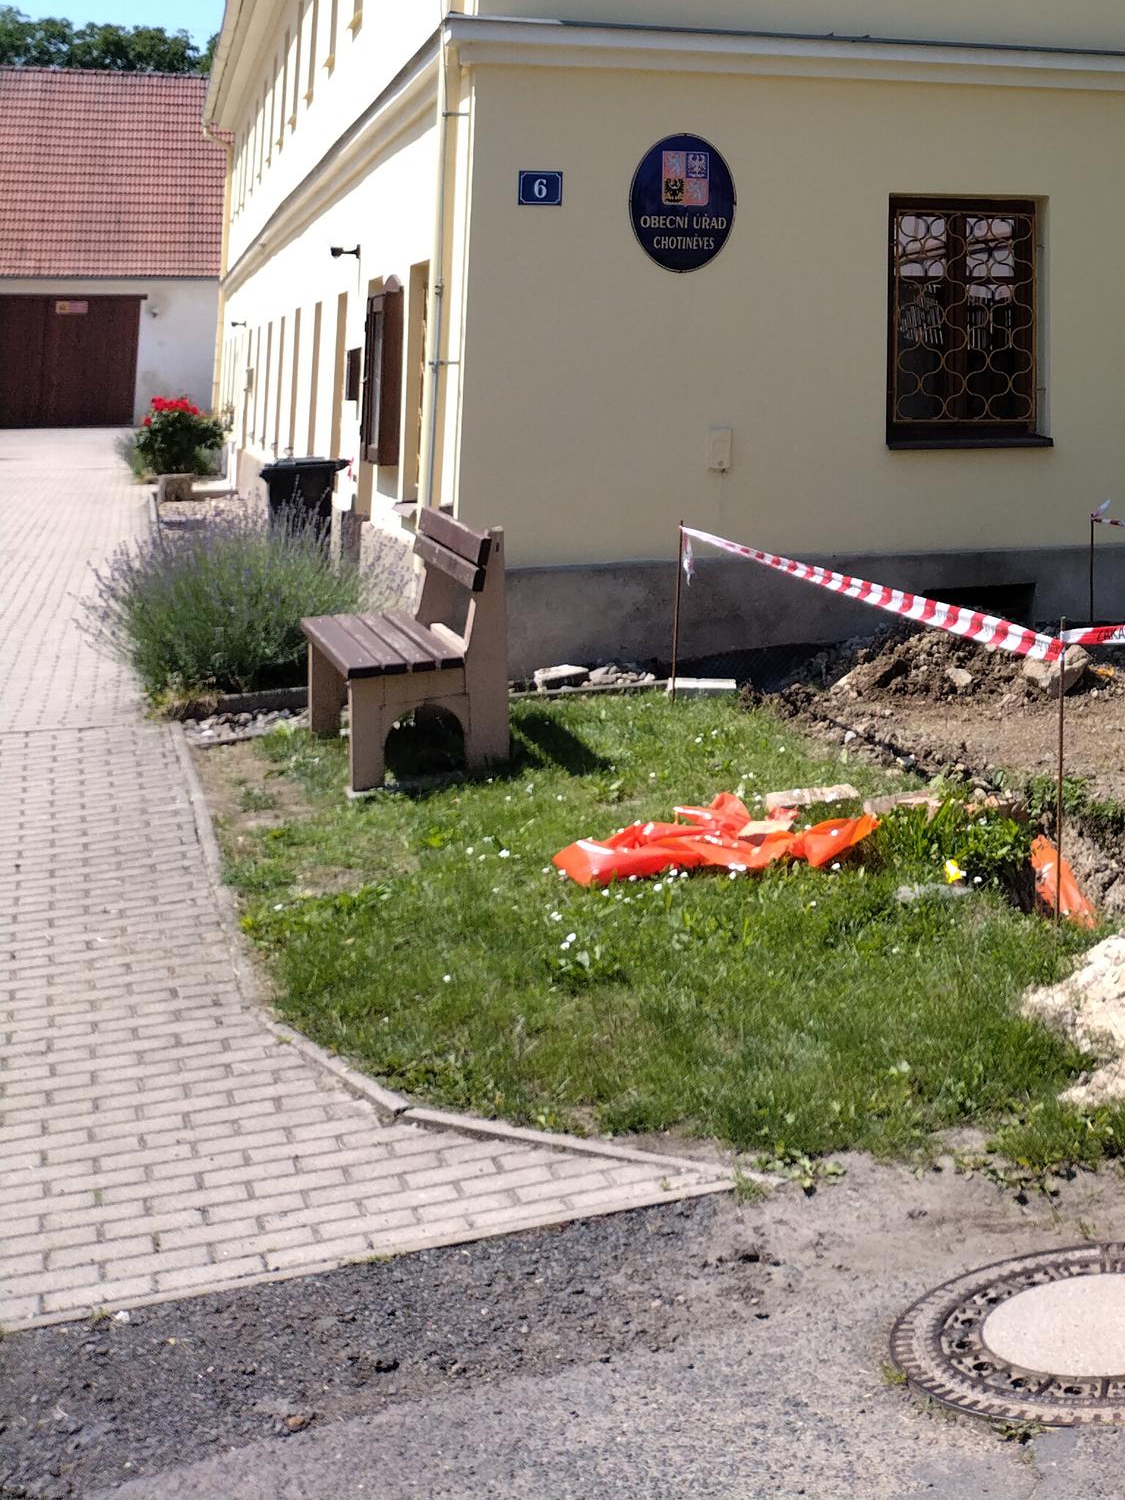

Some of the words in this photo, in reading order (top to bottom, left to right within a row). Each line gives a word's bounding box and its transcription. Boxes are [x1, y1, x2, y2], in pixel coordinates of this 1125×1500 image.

[533, 178, 547, 198] 6
[640, 212, 688, 229] OBECNÍ
[693, 213, 727, 230] ÚŘAD
[653, 233, 715, 250] CHOTINĚVES
